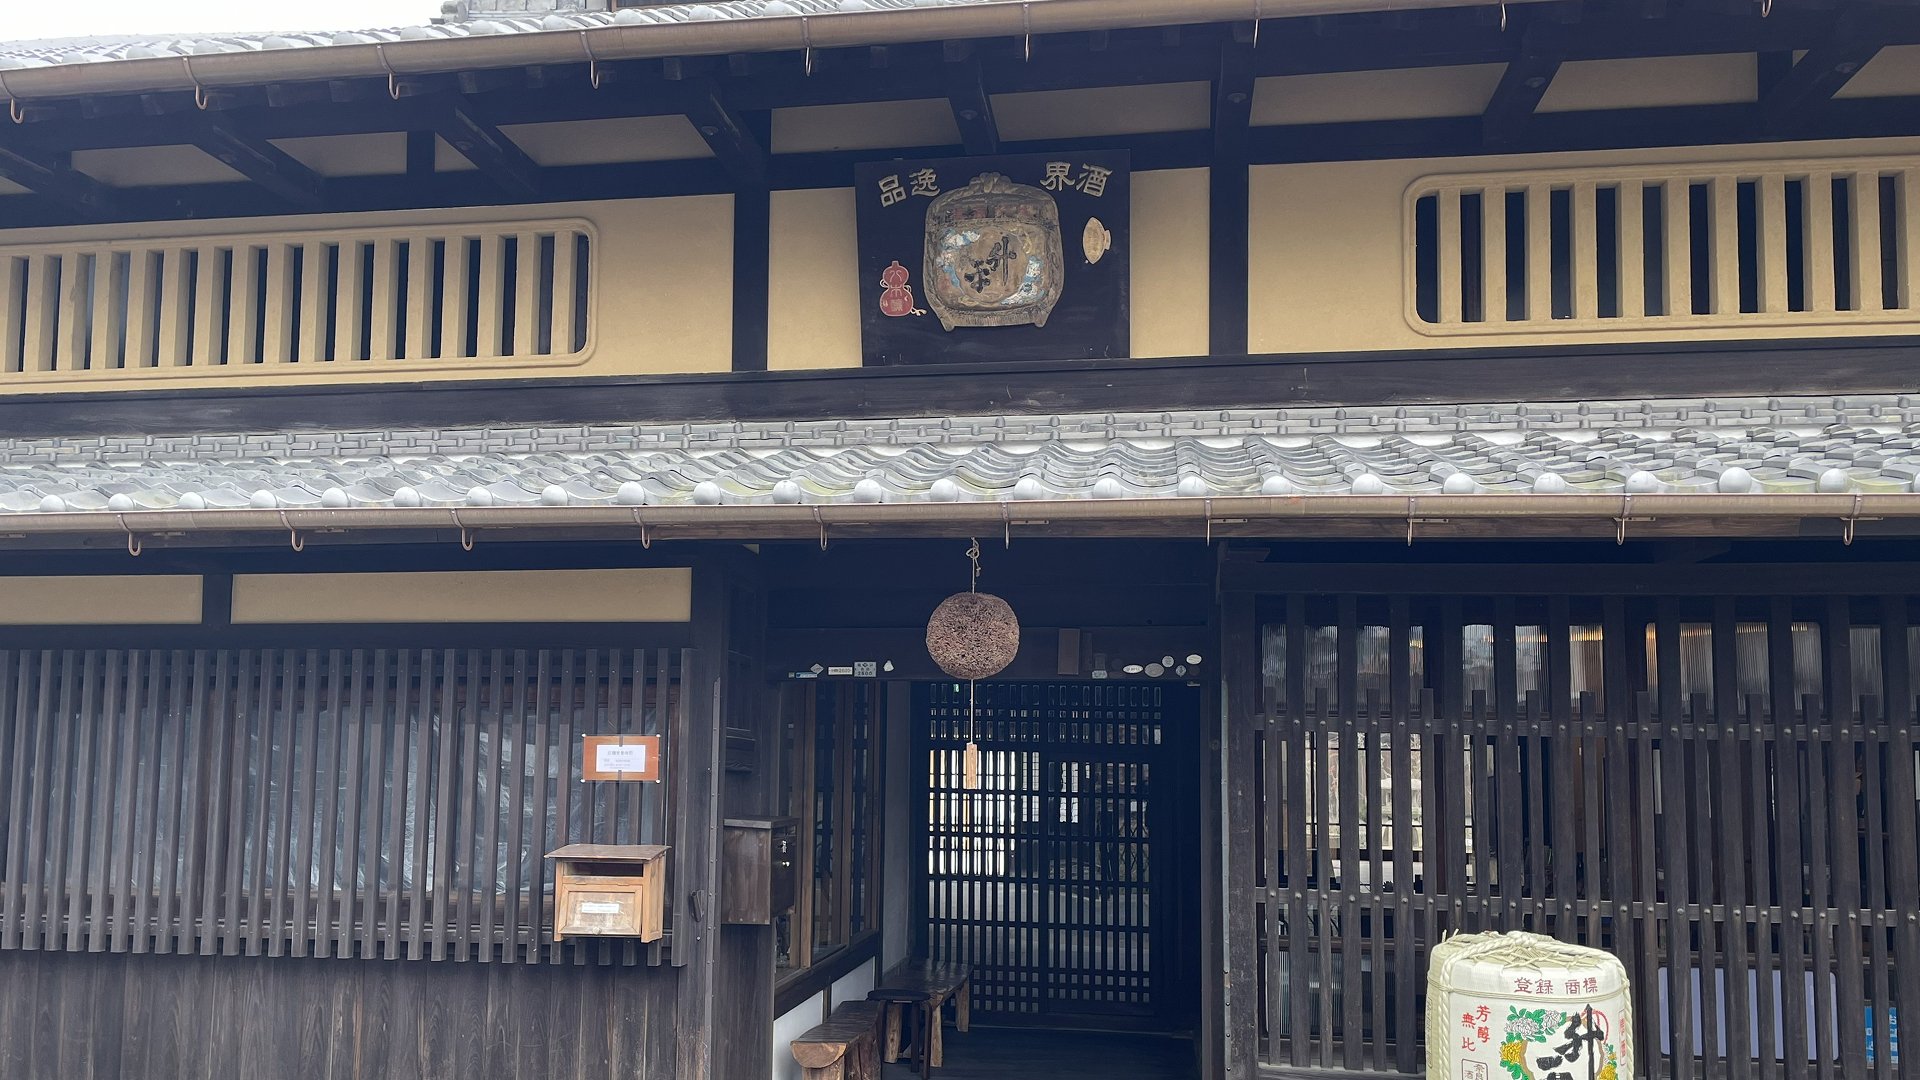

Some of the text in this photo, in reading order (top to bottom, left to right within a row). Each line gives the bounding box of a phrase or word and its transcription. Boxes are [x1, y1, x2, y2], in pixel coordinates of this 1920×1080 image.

[1514, 977, 1598, 994] 登録 商標
[1462, 1012, 1476, 1051] 無比
